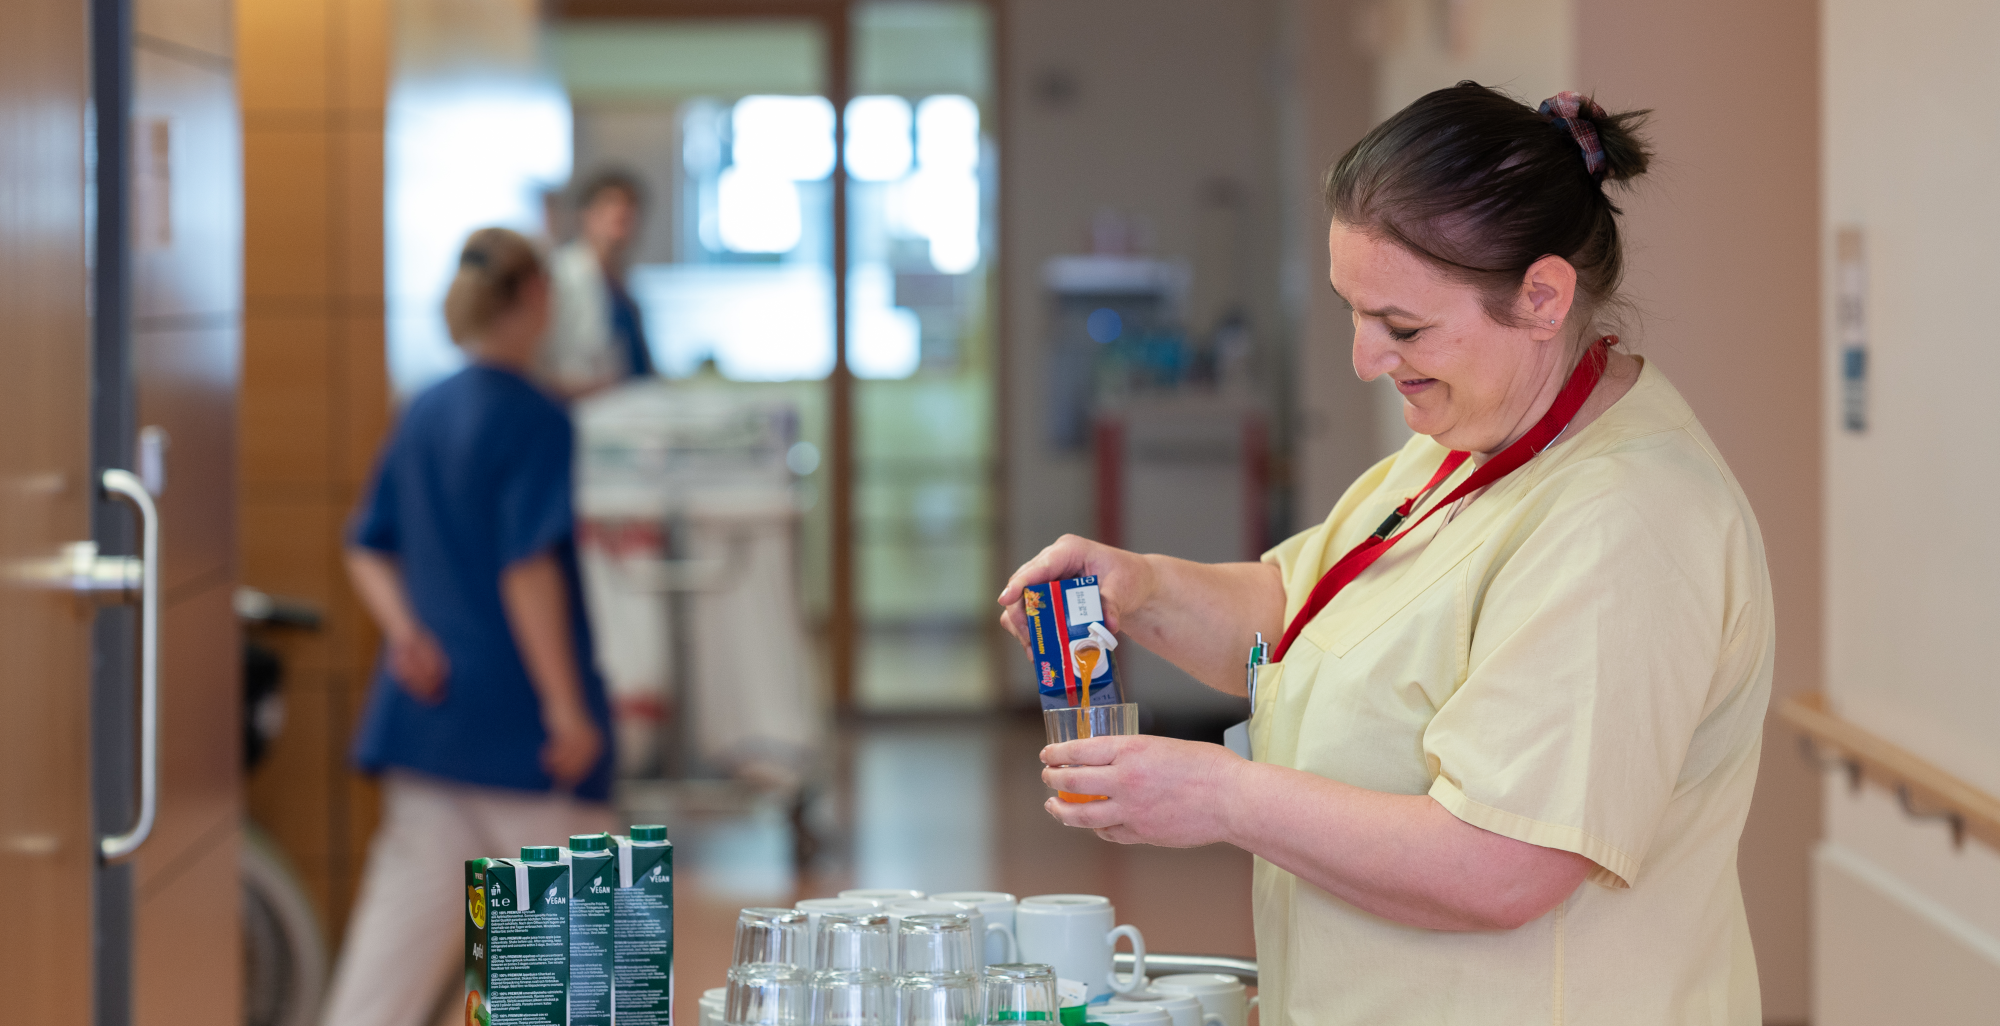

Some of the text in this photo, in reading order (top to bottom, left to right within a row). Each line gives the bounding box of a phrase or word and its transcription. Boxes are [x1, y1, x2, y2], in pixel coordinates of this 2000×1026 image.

[1034, 616, 1045, 654] MULTIVITAMIN
[590, 886, 611, 894] VEGAN
[490, 898, 500, 907] 1L
[545, 897, 566, 905] VEGAN
